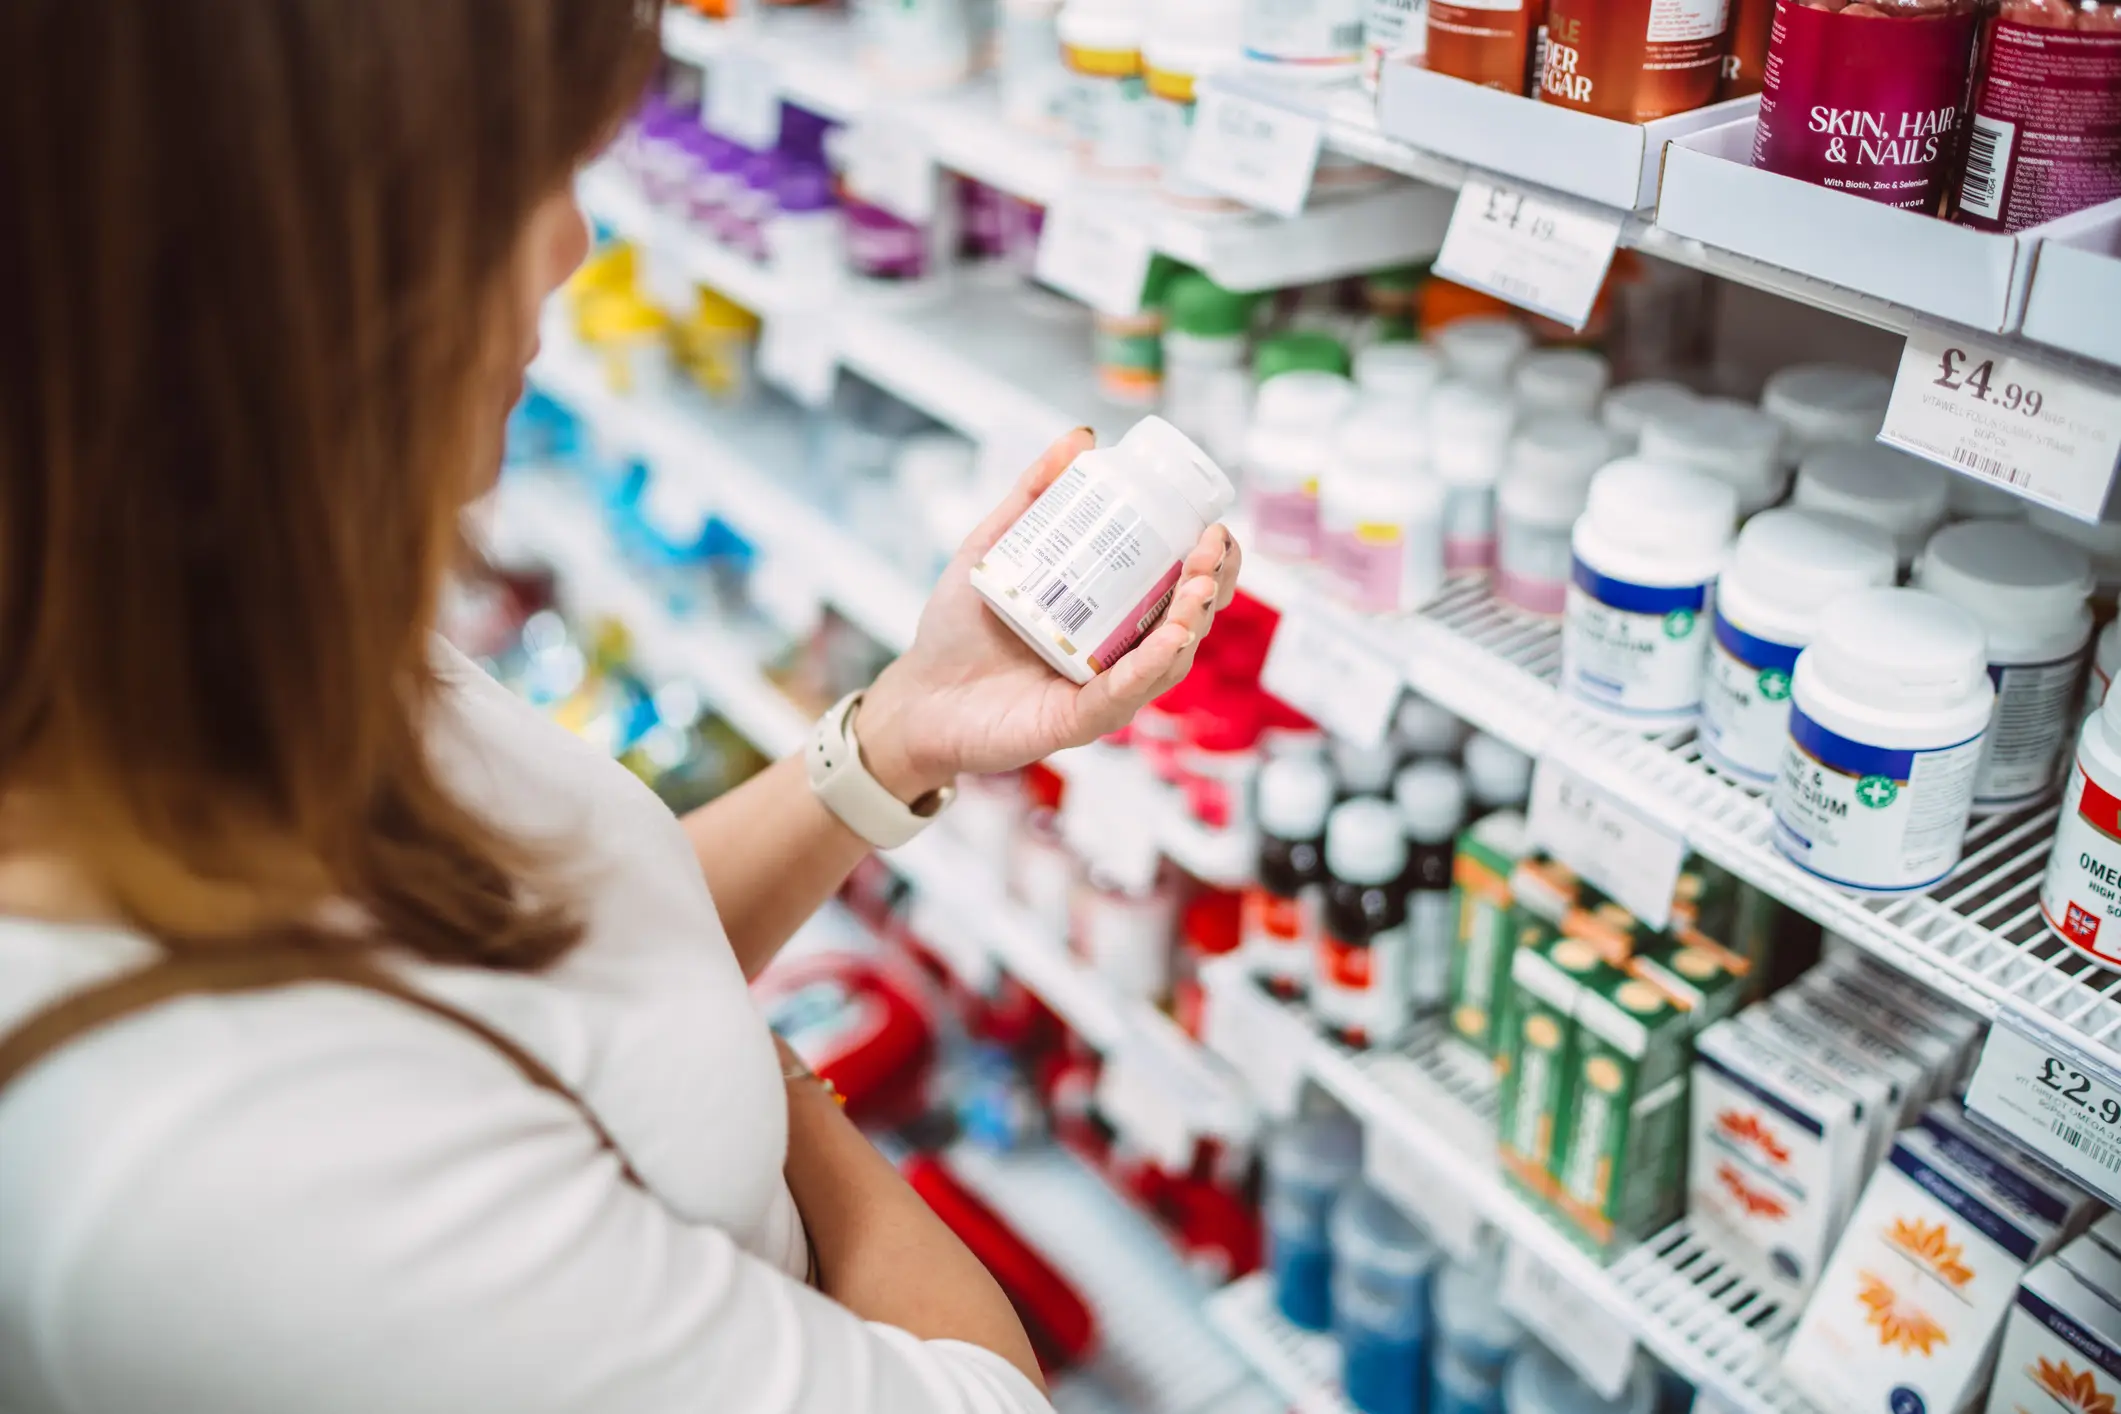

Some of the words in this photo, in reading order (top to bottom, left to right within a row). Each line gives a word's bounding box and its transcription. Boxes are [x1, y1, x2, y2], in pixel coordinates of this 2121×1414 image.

[1808, 105, 1889, 140] SKIN,
[1898, 106, 1955, 138] HAIR
[1824, 136, 1848, 164] &
[1856, 136, 1939, 166] NAILS
[1823, 177, 1844, 188] With
[1845, 179, 1872, 190] Biotin,
[1873, 181, 1891, 190] Zinc
[1892, 181, 1898, 189] &
[1899, 178, 1929, 189] Selenium
[1986, 178, 1997, 200] 1064
[1933, 347, 2043, 418] £4.99
[2036, 1057, 2121, 1128] £2.9
[2069, 1107, 2106, 1134] OMEGA
